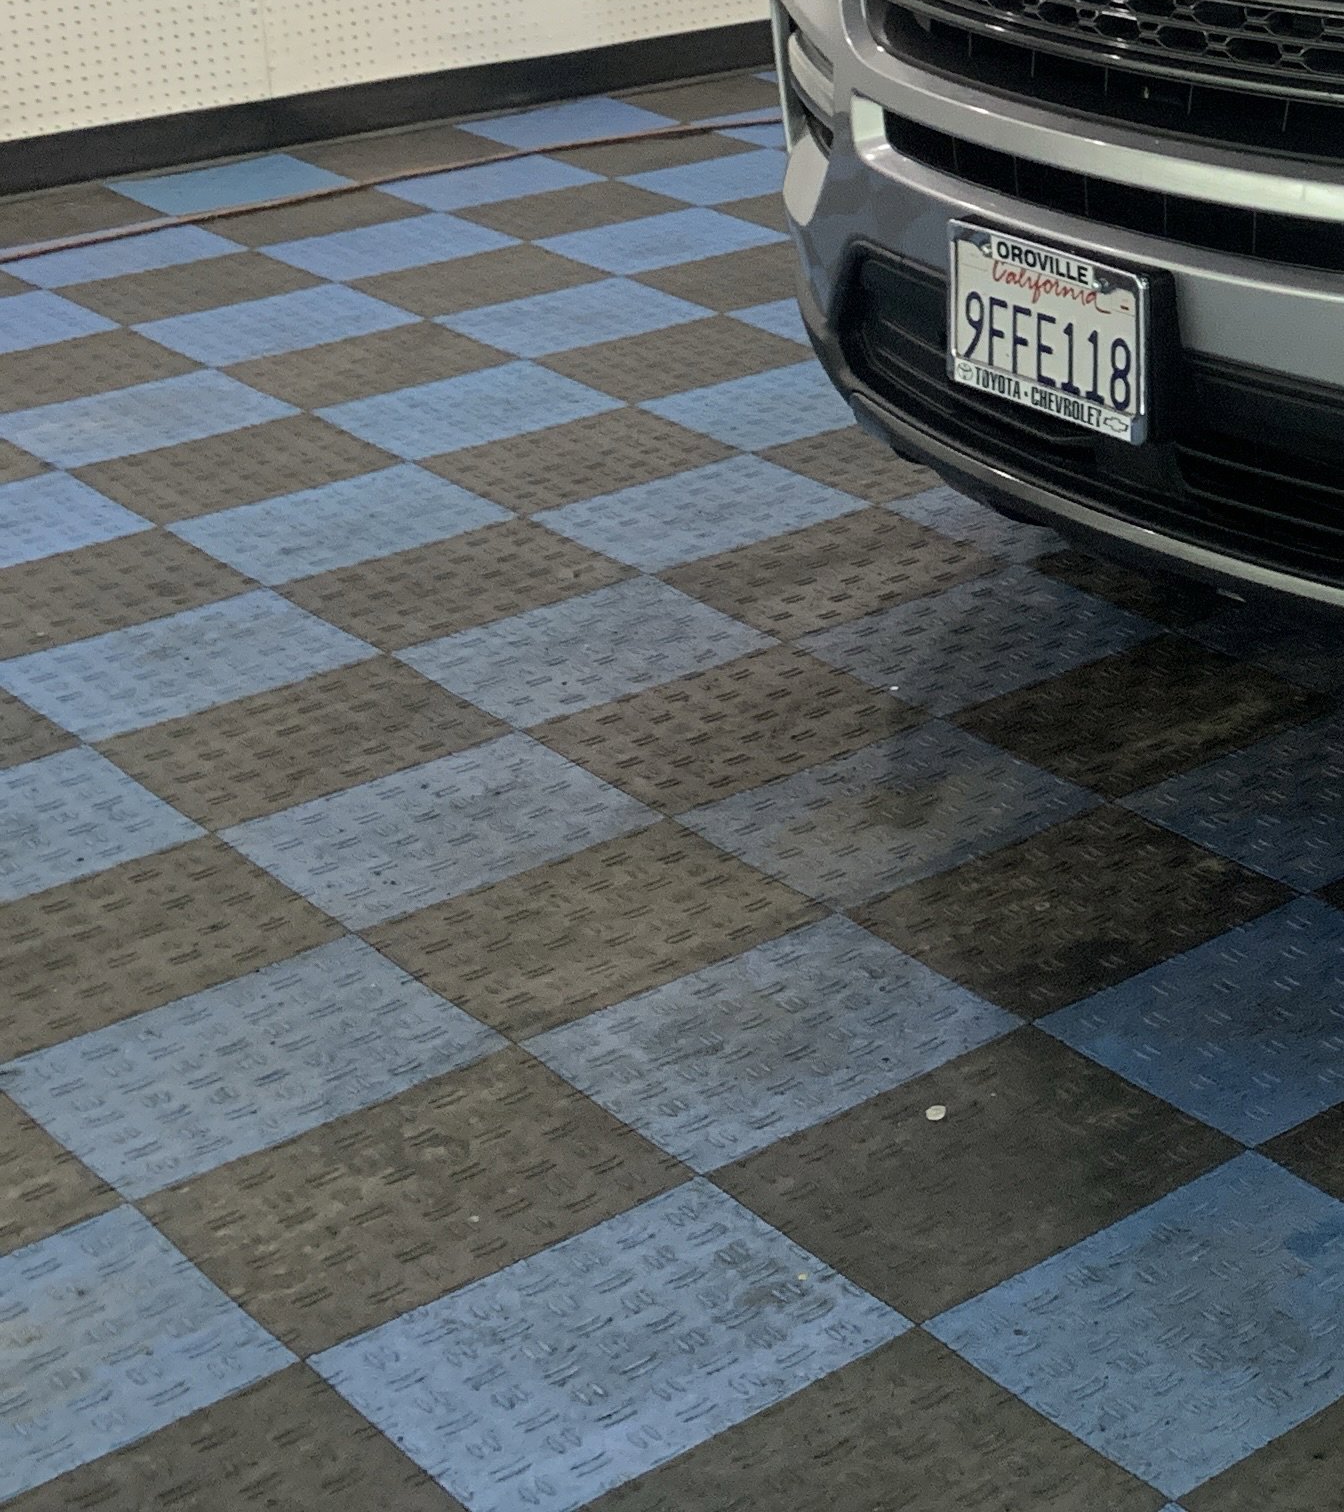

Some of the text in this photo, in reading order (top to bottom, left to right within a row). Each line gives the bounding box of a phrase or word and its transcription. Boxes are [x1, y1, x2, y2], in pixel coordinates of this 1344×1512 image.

[992, 260, 1111, 314] California
[995, 240, 1090, 285] OROVILLE
[963, 290, 1132, 411] 9FFE118
[974, 366, 1103, 428] TOYOTA CHEVROLET
